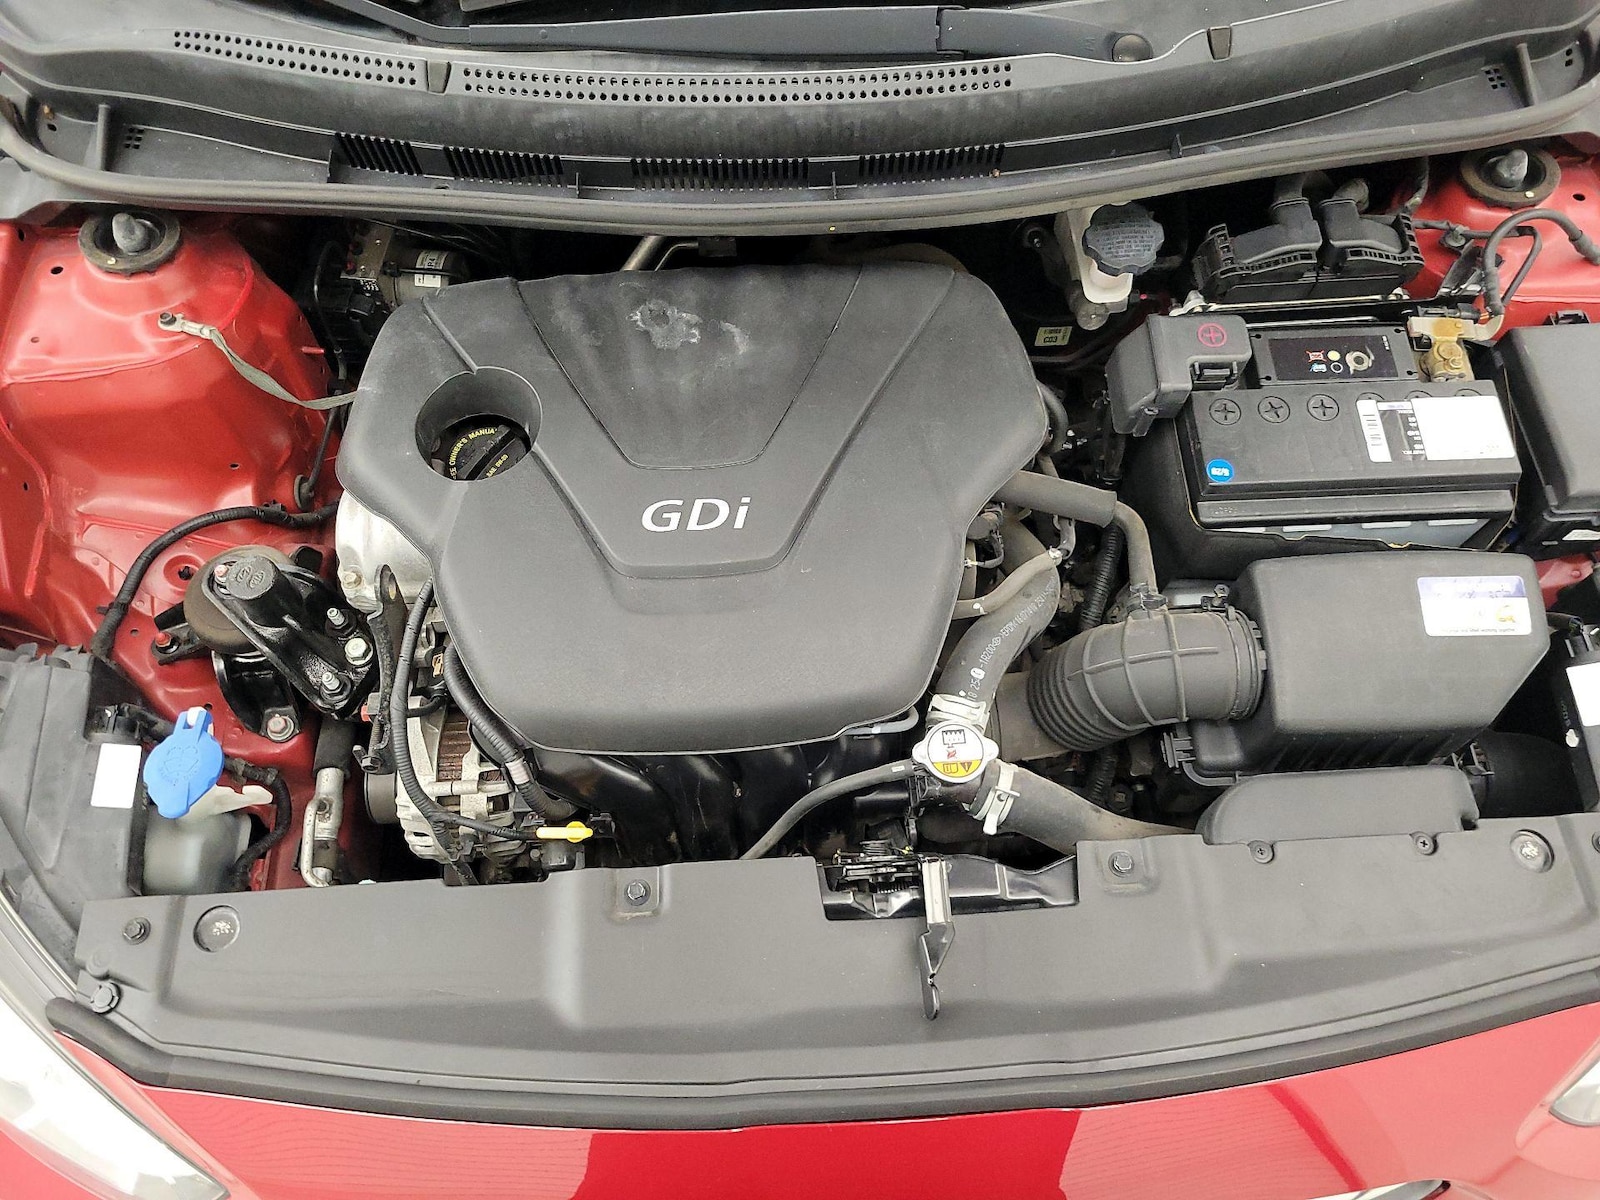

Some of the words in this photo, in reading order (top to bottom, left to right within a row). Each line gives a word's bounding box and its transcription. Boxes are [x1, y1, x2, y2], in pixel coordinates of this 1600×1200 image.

[448, 438, 468, 466] OWNER'S
[468, 428, 498, 440] MANUA
[641, 496, 751, 532] GDi
